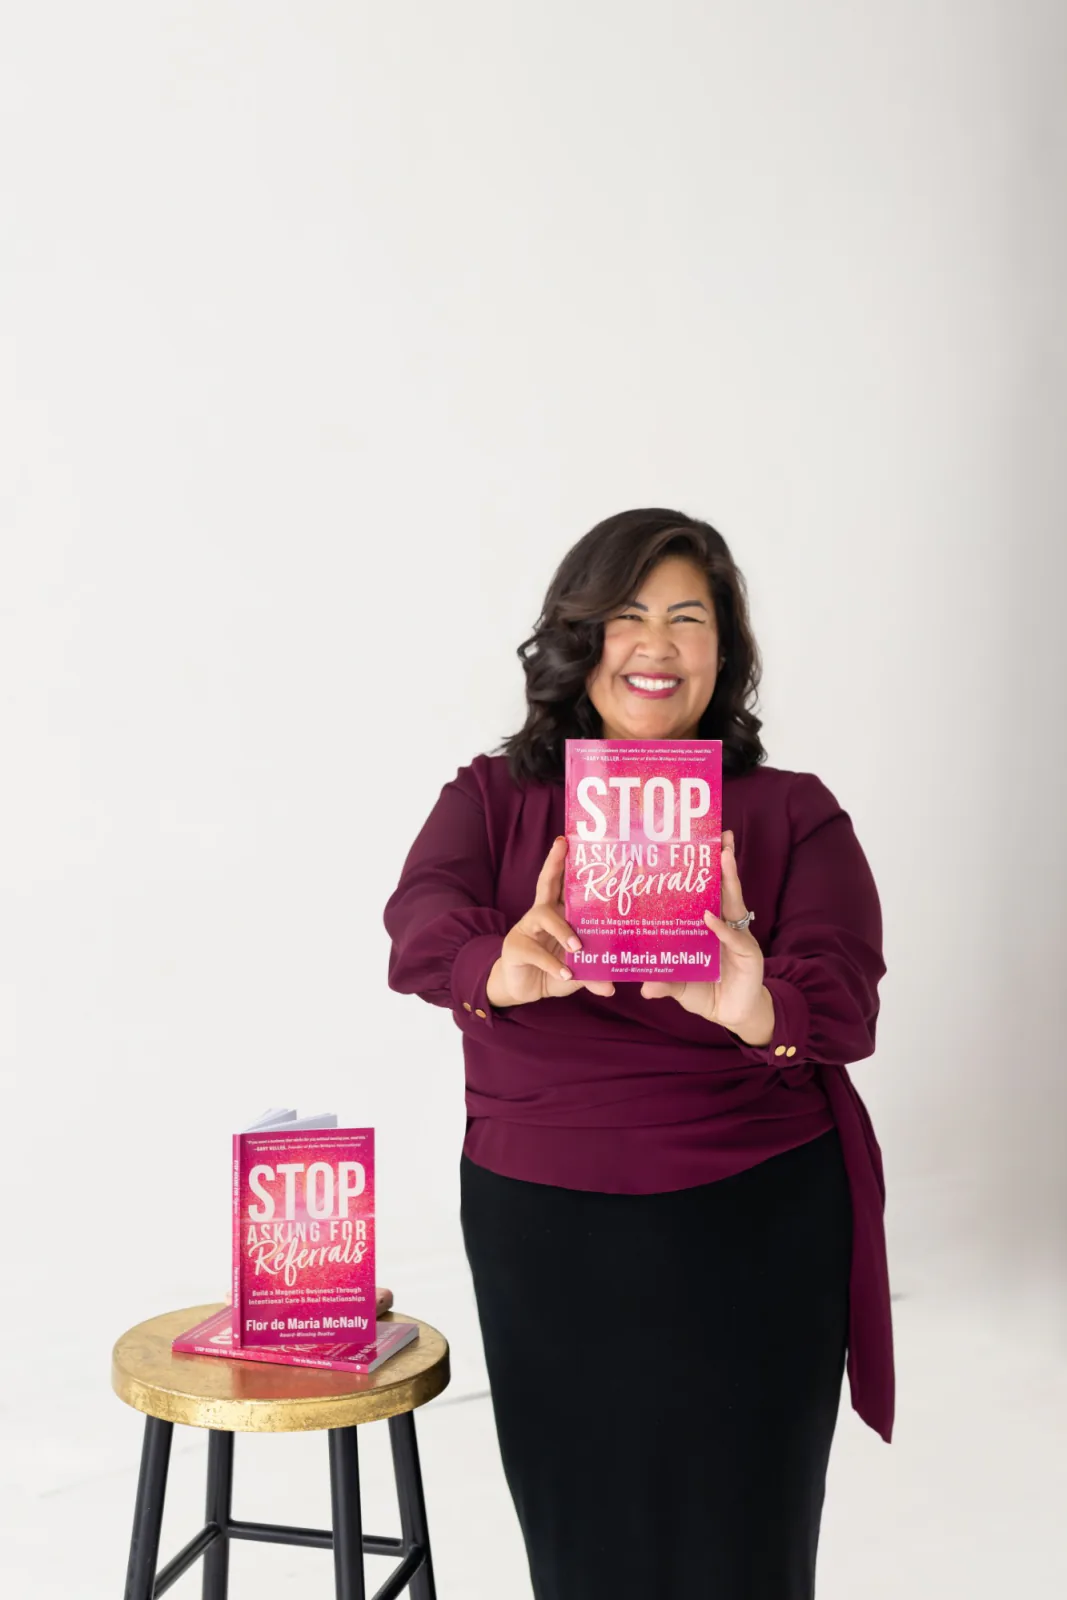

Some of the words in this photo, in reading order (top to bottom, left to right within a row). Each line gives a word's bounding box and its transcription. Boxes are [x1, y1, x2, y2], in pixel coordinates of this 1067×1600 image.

[576, 776, 710, 842] STOP
[574, 844, 658, 867] ASKING
[670, 844, 711, 867] FOR
[576, 859, 713, 916] Referrals
[581, 917, 599, 925] Build
[606, 918, 640, 927] Magnetic
[642, 918, 673, 926] Business
[675, 918, 704, 927] Through
[577, 927, 617, 935] Intentional
[660, 928, 709, 937] Relationships
[574, 951, 599, 964] Flor
[601, 951, 618, 964] de
[620, 951, 658, 965] Maria
[660, 951, 712, 967] McNally
[248, 1161, 366, 1222] STOP
[247, 1222, 320, 1245] ASKING
[330, 1220, 366, 1242] FOR
[248, 1234, 368, 1287] Referrals
[322, 1295, 366, 1303] Relationships
[335, 1286, 362, 1295] Through
[246, 1319, 269, 1331] Flor
[270, 1318, 285, 1330] de
[287, 1317, 320, 1330] Maria
[322, 1315, 369, 1330] McNally
